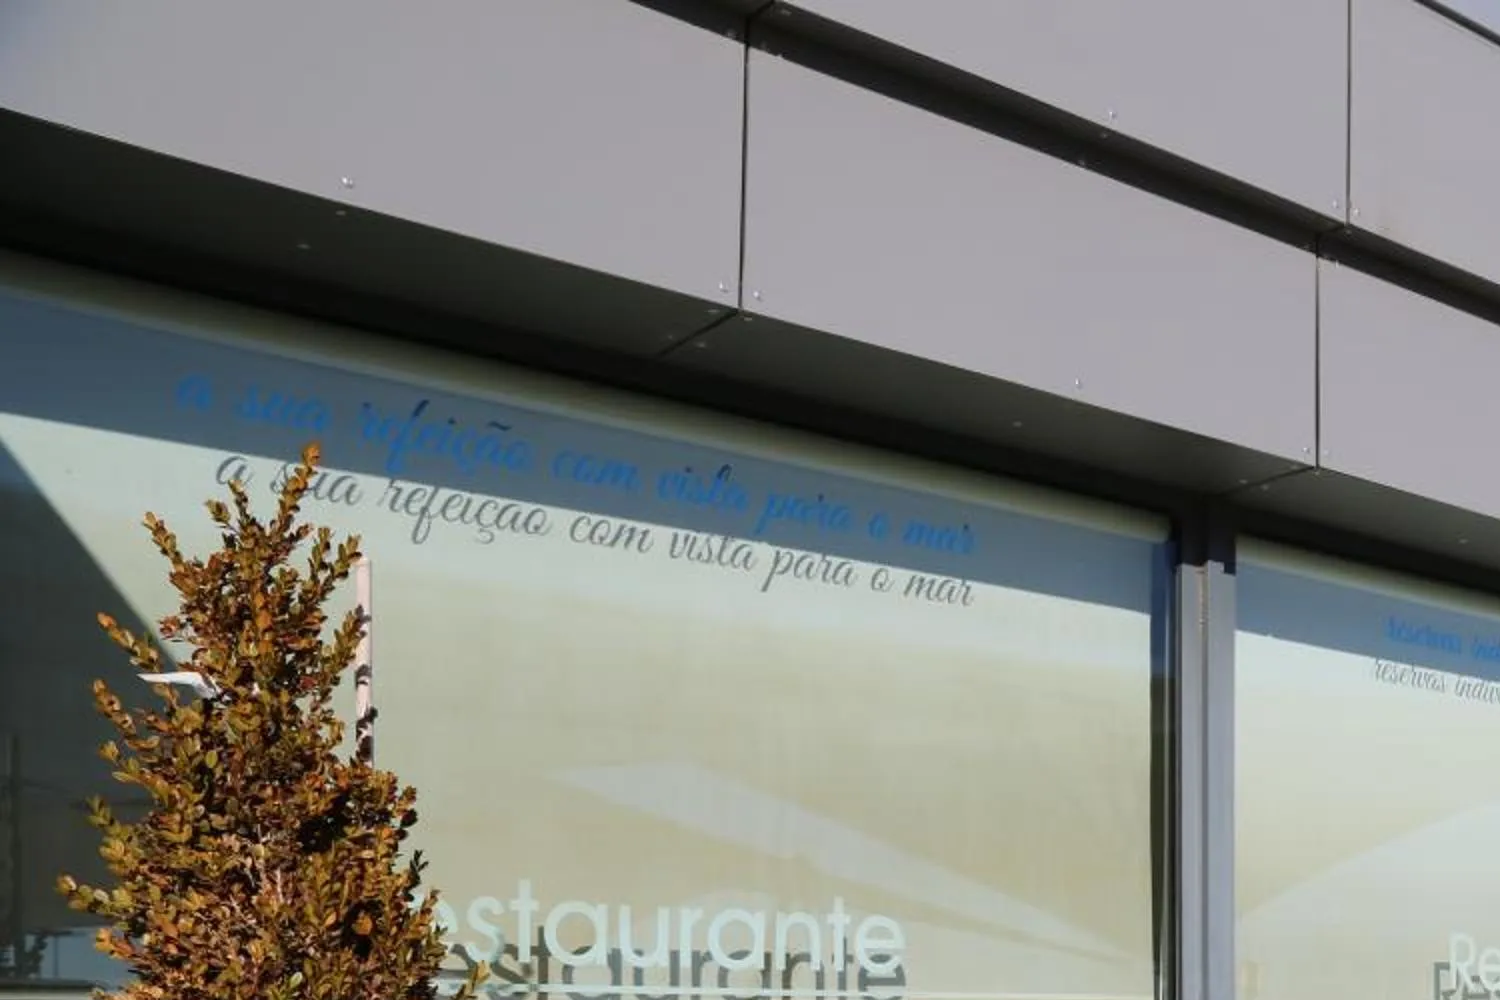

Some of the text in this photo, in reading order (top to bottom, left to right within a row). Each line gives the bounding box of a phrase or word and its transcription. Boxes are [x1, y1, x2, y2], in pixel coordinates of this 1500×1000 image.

[550, 446, 643, 494] com
[655, 463, 749, 516] vista
[753, 490, 853, 540] para
[568, 510, 655, 555] com
[668, 532, 760, 573] vista
[760, 545, 860, 594] para
[870, 564, 895, 594] o
[902, 578, 975, 608] mar
[408, 878, 906, 977] staurante
